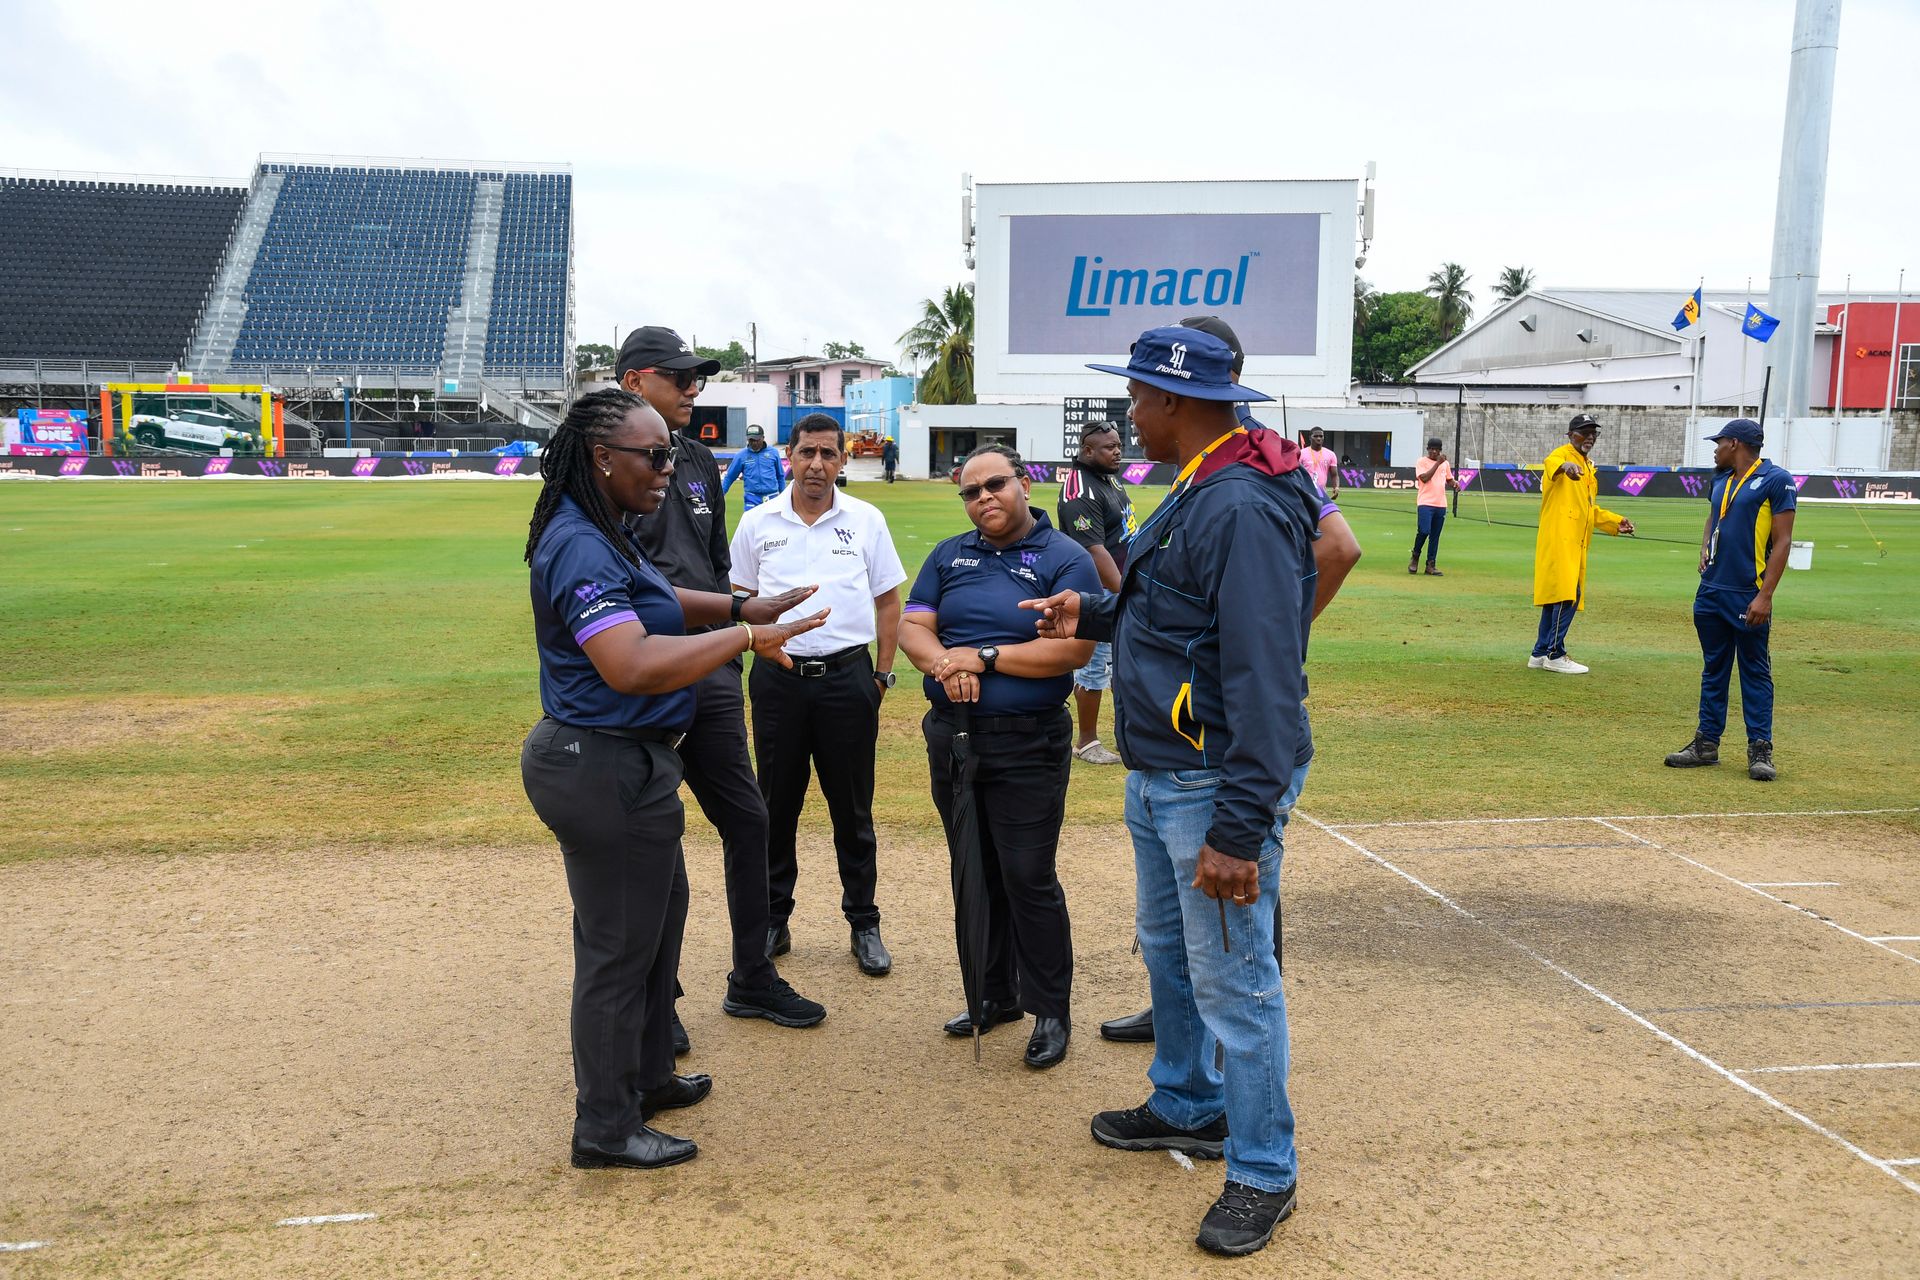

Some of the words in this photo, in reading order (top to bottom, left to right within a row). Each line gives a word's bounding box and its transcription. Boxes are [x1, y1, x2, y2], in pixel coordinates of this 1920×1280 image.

[1066, 255, 1250, 316] Limacol
[1065, 399, 1085, 409] 1ST
[1088, 399, 1107, 409] INN
[1065, 411, 1085, 421] 1ST
[1088, 411, 1107, 421] INN
[36, 430, 73, 441] ONE
[1374, 471, 1396, 480] Limacol
[1865, 491, 1913, 500] WCPL
[763, 537, 789, 551] Limacol
[832, 549, 858, 557] WCPL
[580, 600, 617, 619] WCPL
